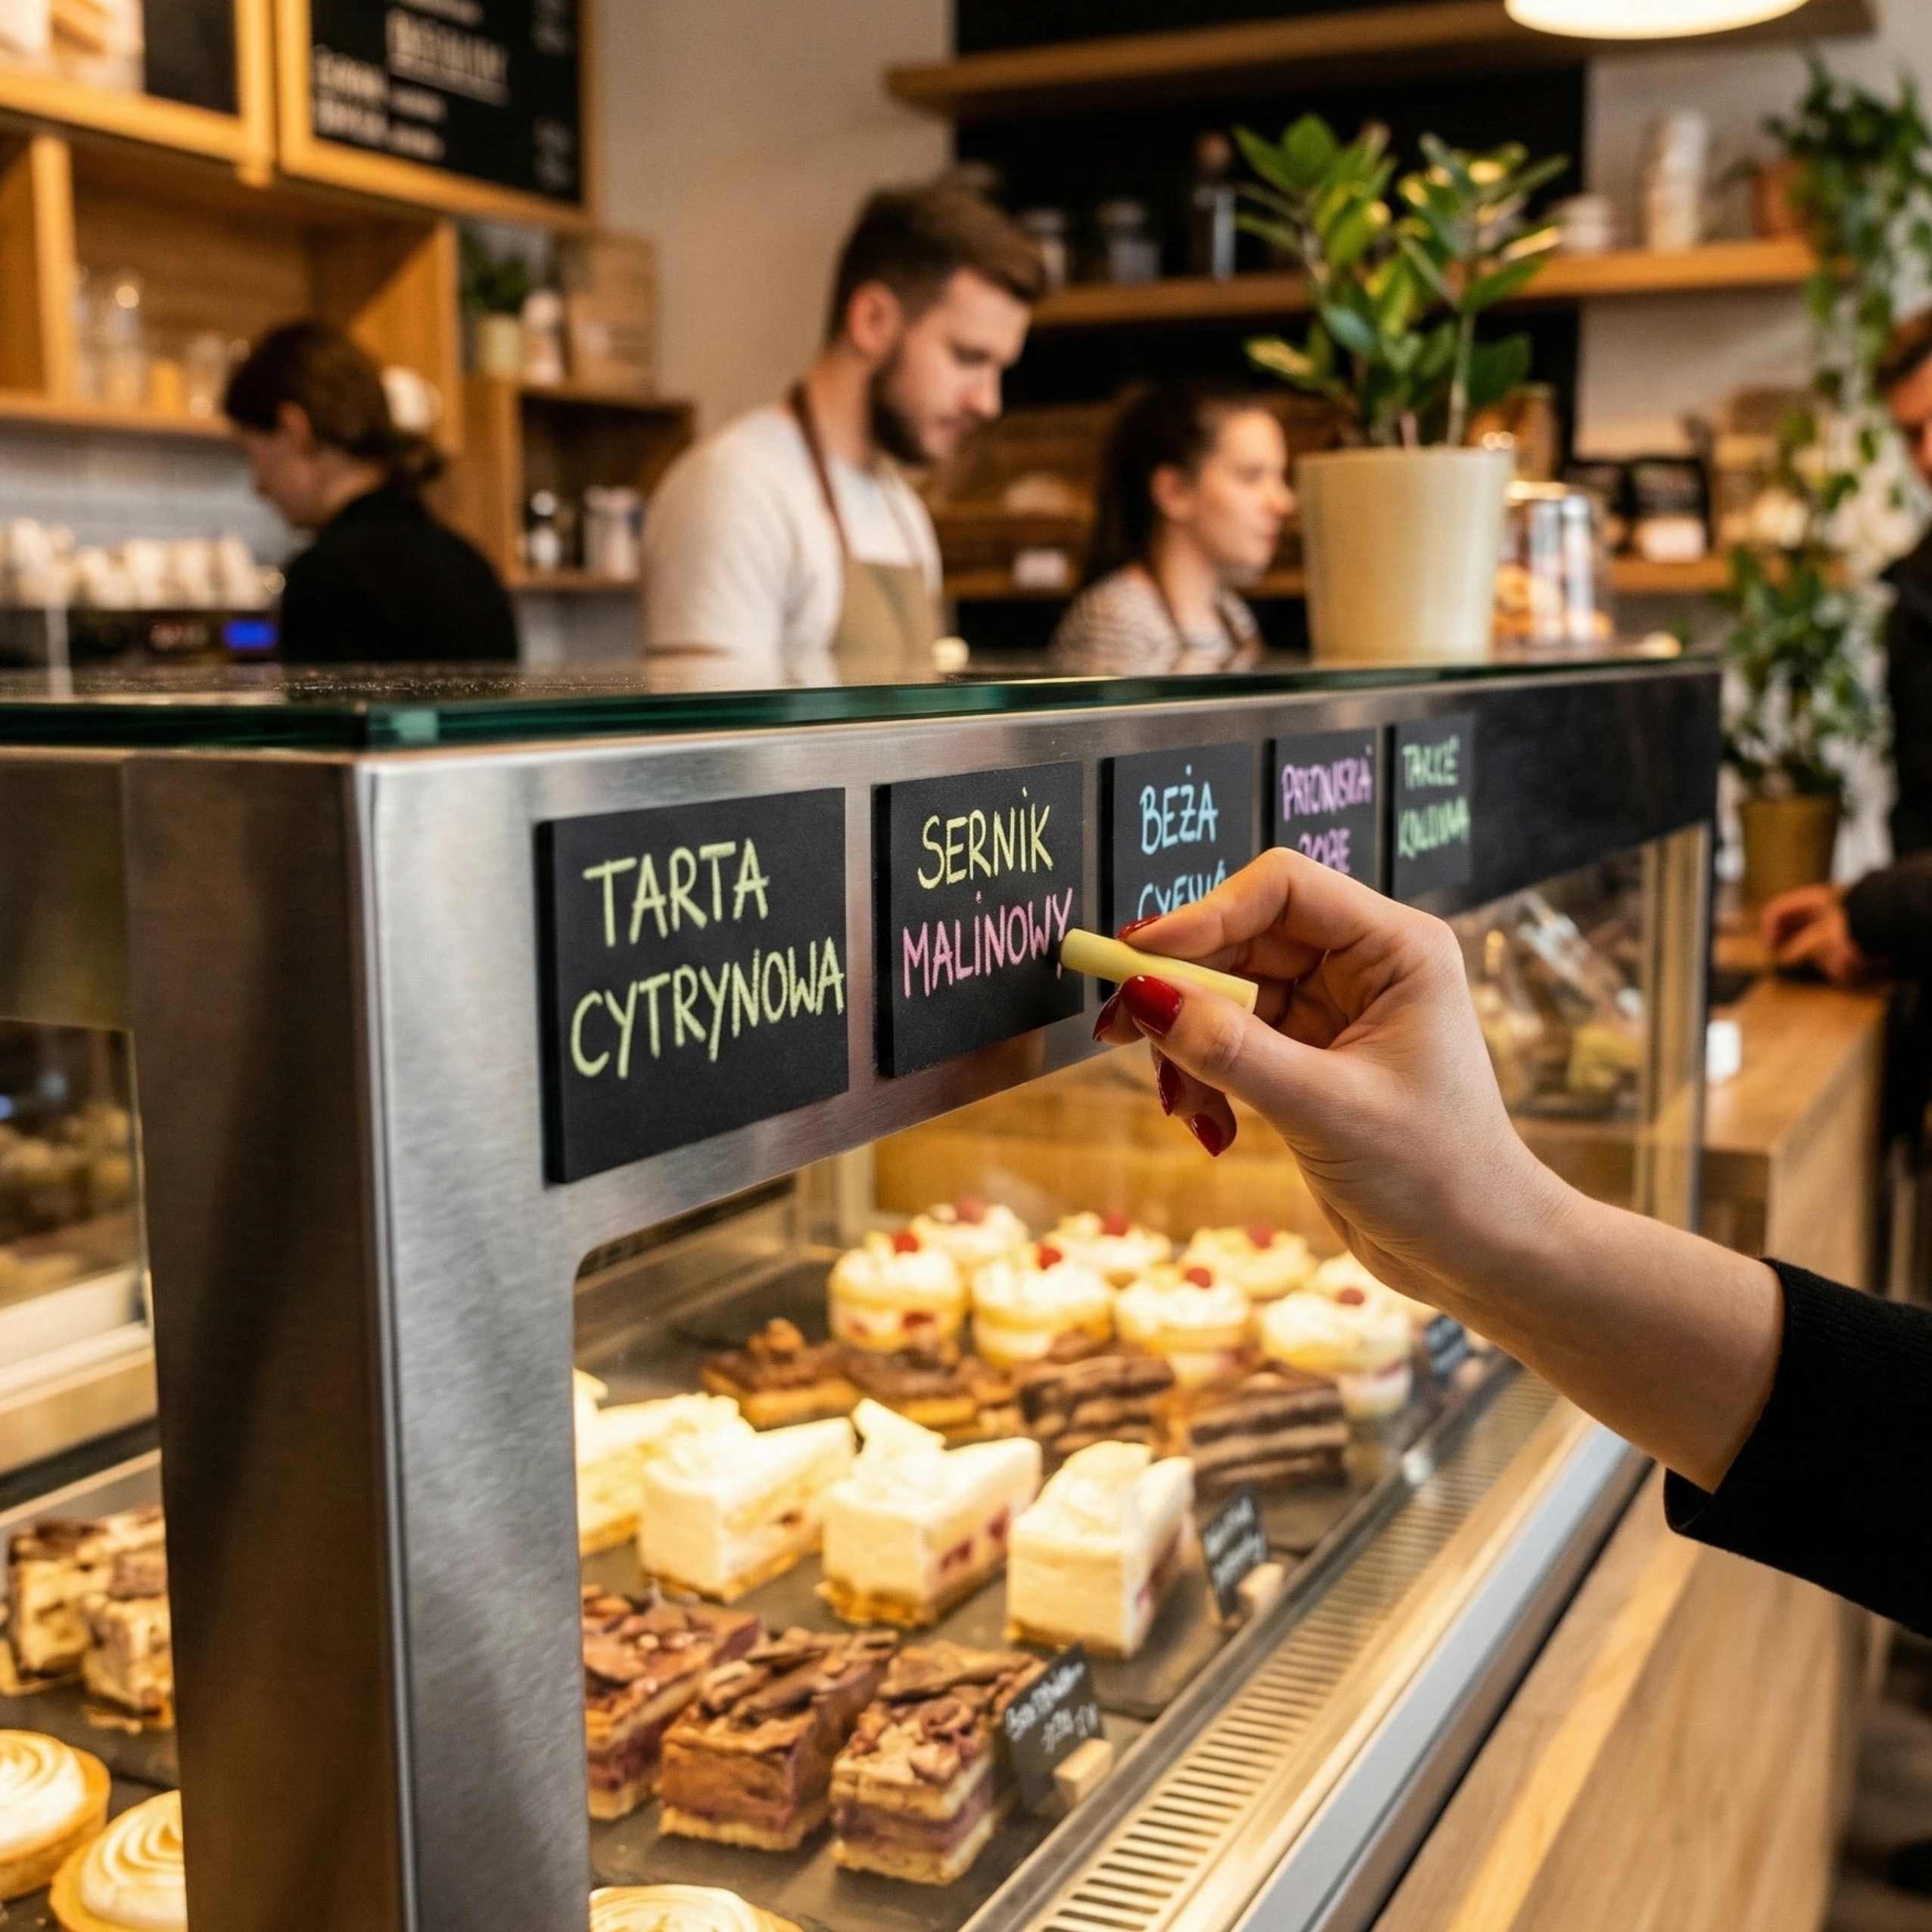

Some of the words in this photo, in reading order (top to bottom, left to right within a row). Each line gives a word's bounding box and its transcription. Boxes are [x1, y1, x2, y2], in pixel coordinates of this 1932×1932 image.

[1139, 764, 1220, 855] BEŻA
[583, 837, 781, 947] TARTA
[571, 936, 845, 1079] CYTRYNOWA
